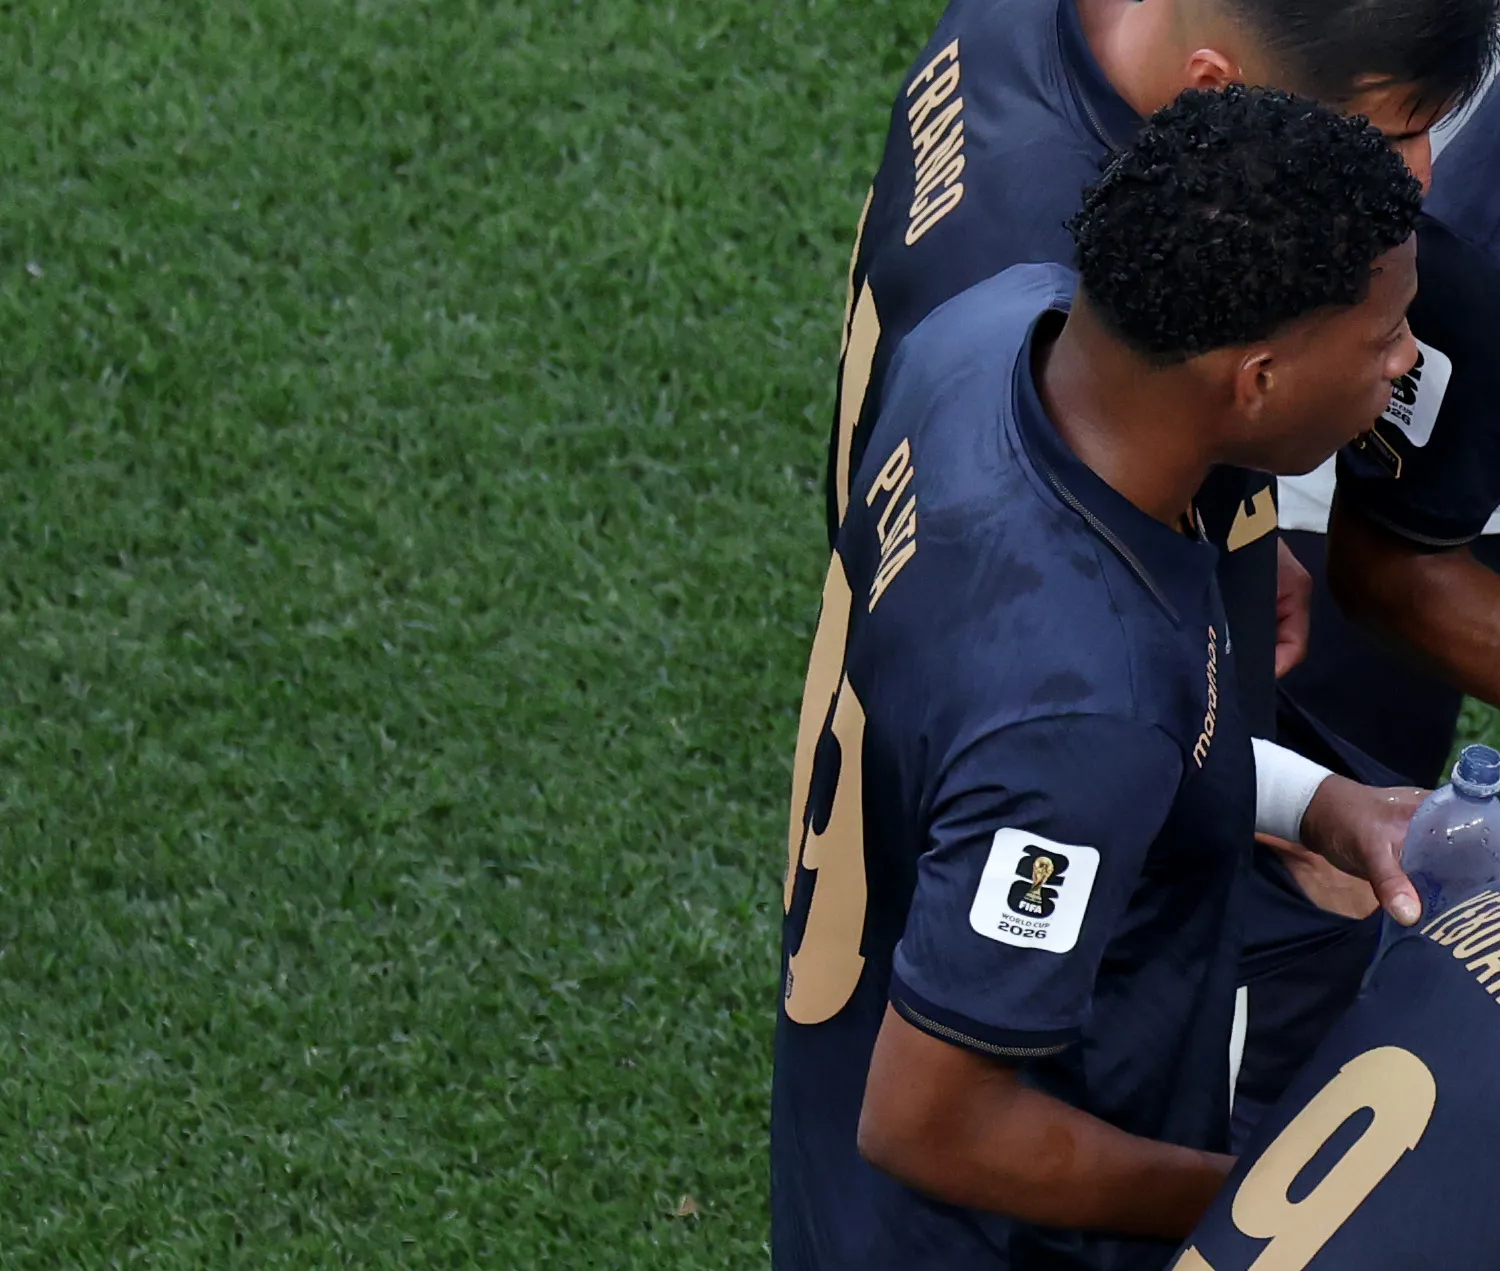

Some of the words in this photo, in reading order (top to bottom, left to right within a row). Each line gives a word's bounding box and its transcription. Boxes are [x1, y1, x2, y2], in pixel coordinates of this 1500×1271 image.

[907, 37, 967, 246] FRANCO
[865, 437, 917, 614] PLATA
[1018, 900, 1043, 914] FIFA
[997, 920, 1047, 940] 2026
[1001, 912, 1033, 928] WORLD
[1033, 921, 1051, 930] CUP
